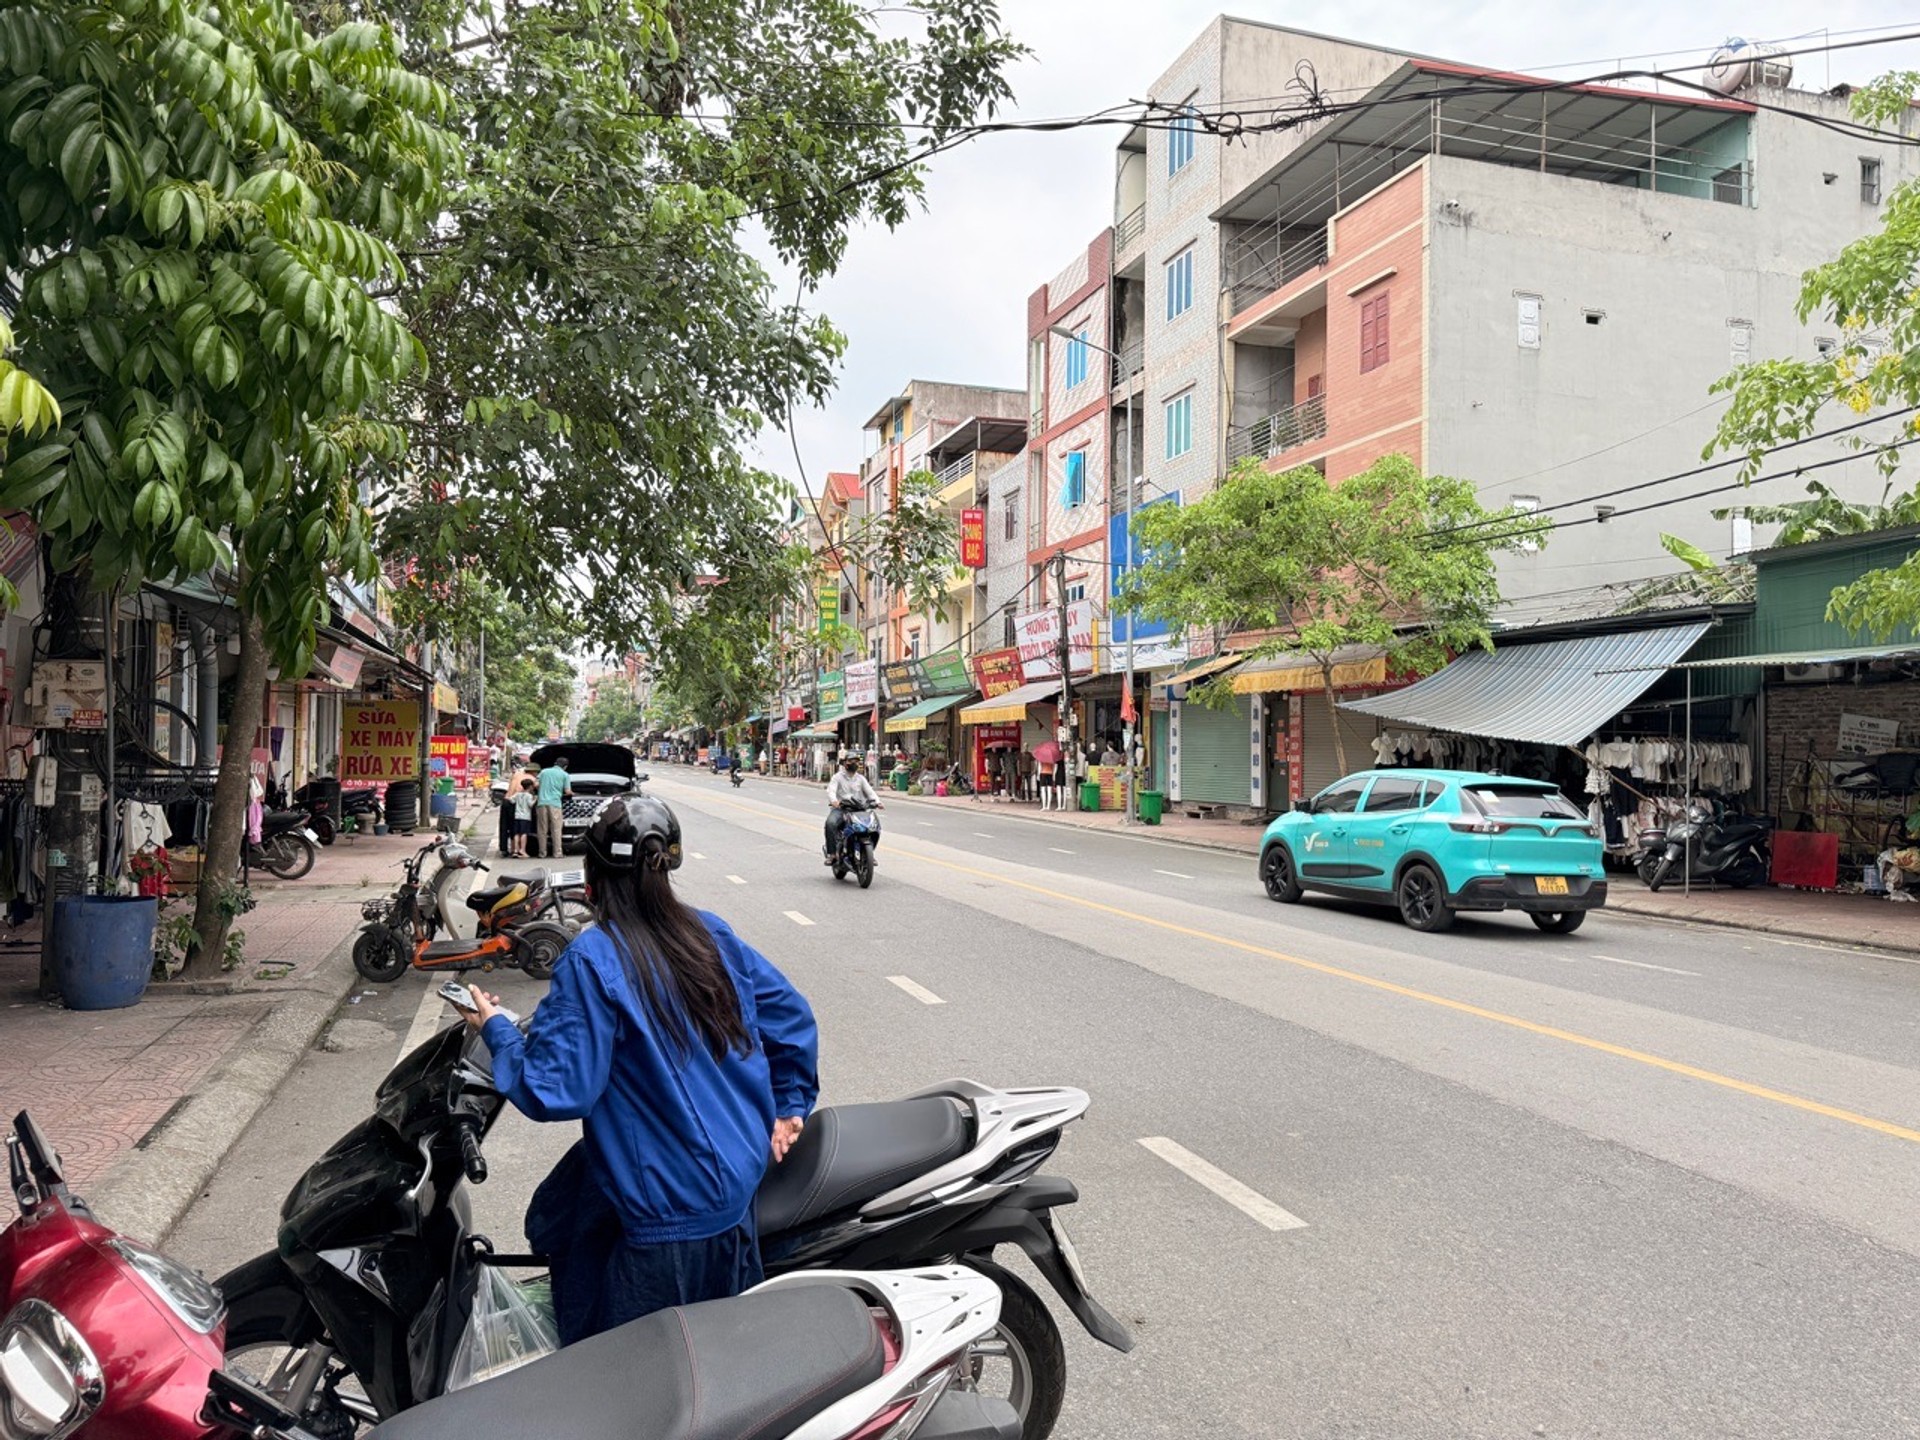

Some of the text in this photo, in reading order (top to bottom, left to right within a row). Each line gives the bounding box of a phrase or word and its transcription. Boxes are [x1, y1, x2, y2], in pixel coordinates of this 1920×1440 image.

[358, 708, 396, 725] SỬA
[350, 728, 415, 747] XE MÁY
[430, 742, 449, 754] THAY
[450, 738, 467, 754] DẦU
[346, 750, 412, 776] RỬA XE
